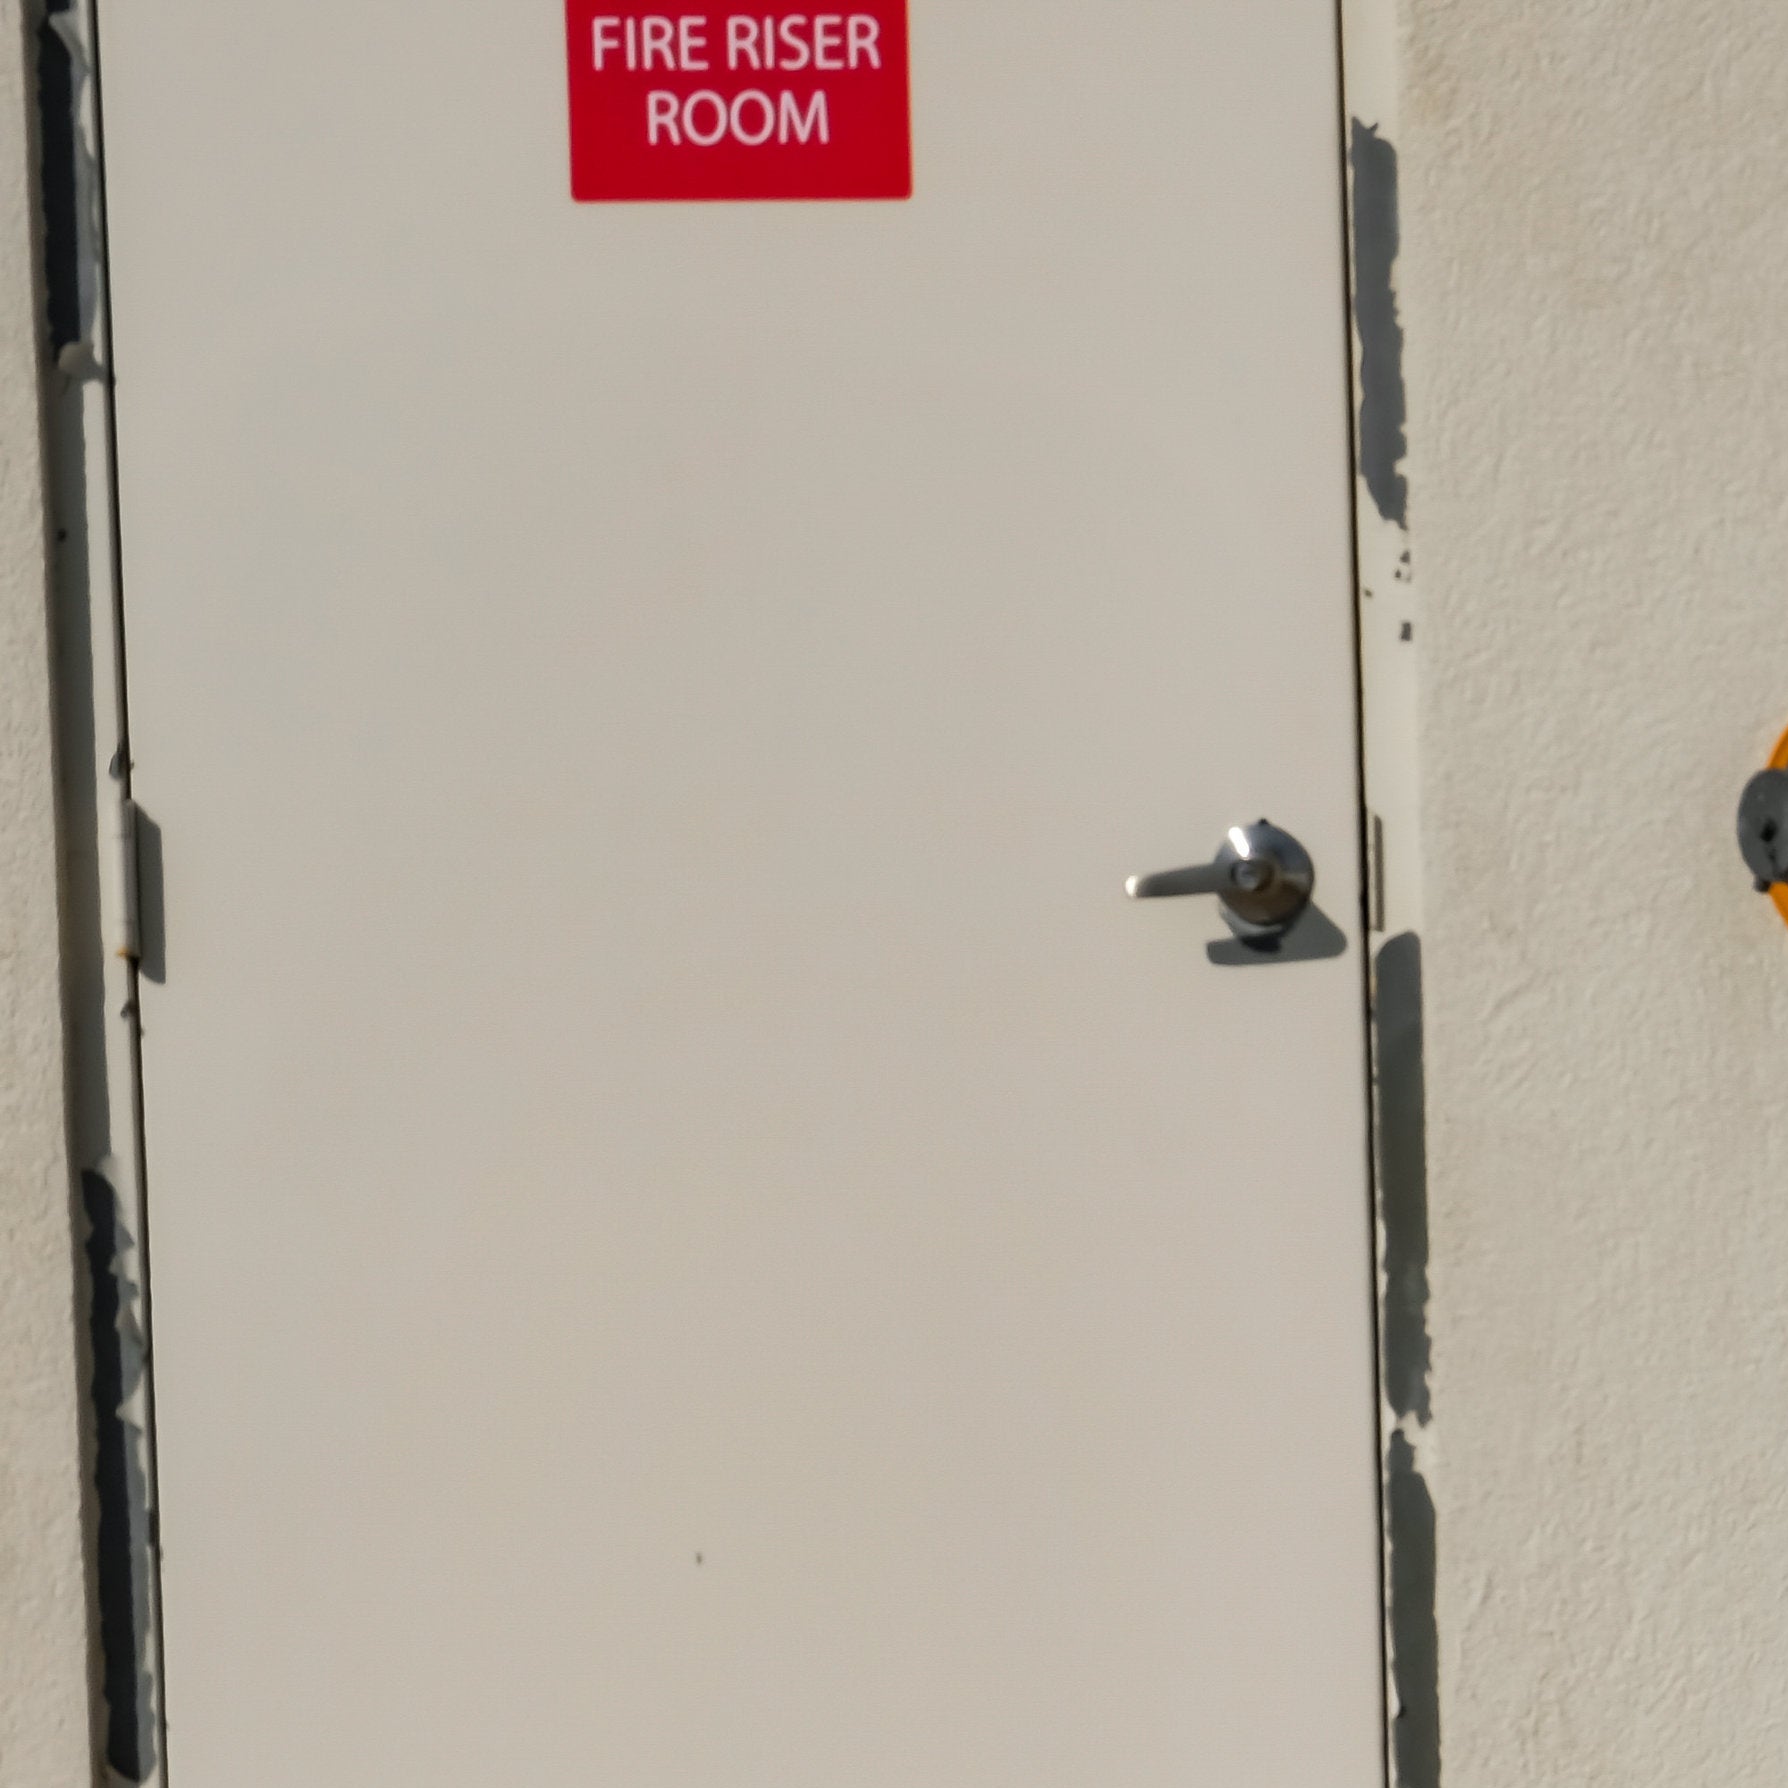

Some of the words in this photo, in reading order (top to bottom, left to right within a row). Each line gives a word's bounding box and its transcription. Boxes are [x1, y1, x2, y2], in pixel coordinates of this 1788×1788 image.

[592, 15, 709, 71] FIRE
[726, 14, 880, 71] RISER
[647, 89, 829, 146] ROOM
